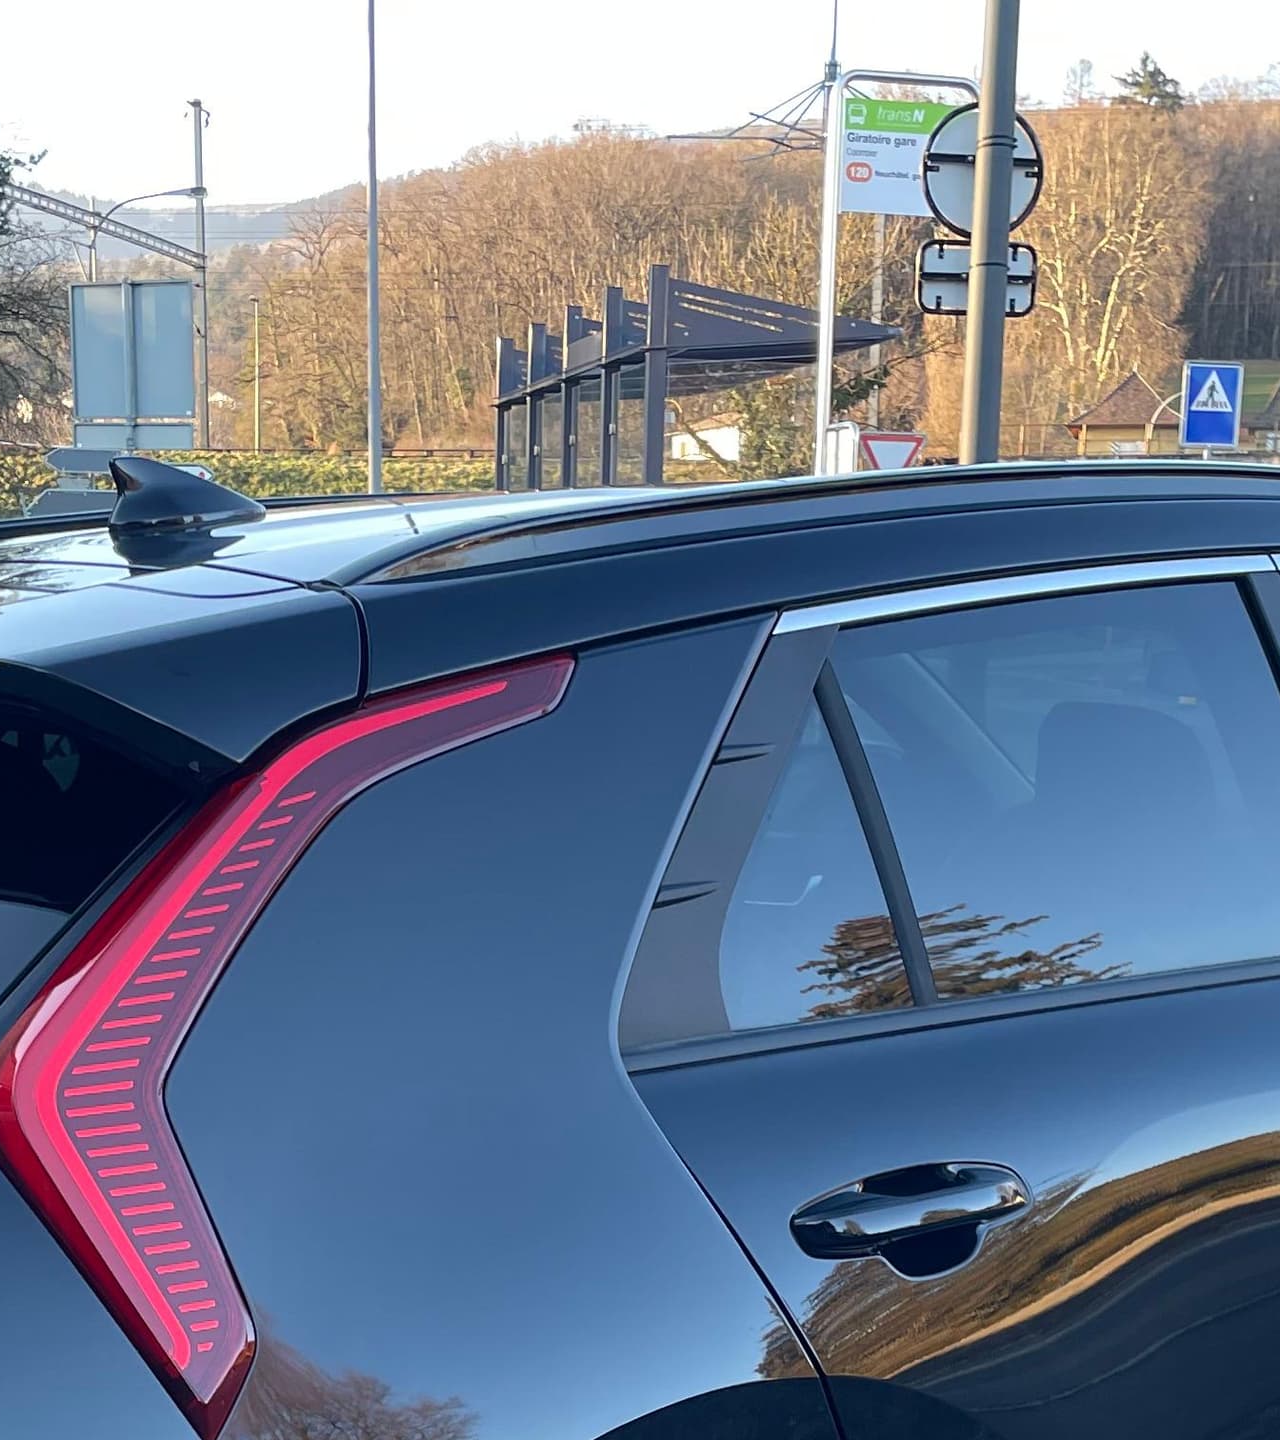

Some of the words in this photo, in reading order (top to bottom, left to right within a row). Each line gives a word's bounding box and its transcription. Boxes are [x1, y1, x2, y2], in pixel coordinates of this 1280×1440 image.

[877, 106, 925, 123] transN
[847, 132, 892, 146] Giratoire
[894, 137, 918, 149] gare
